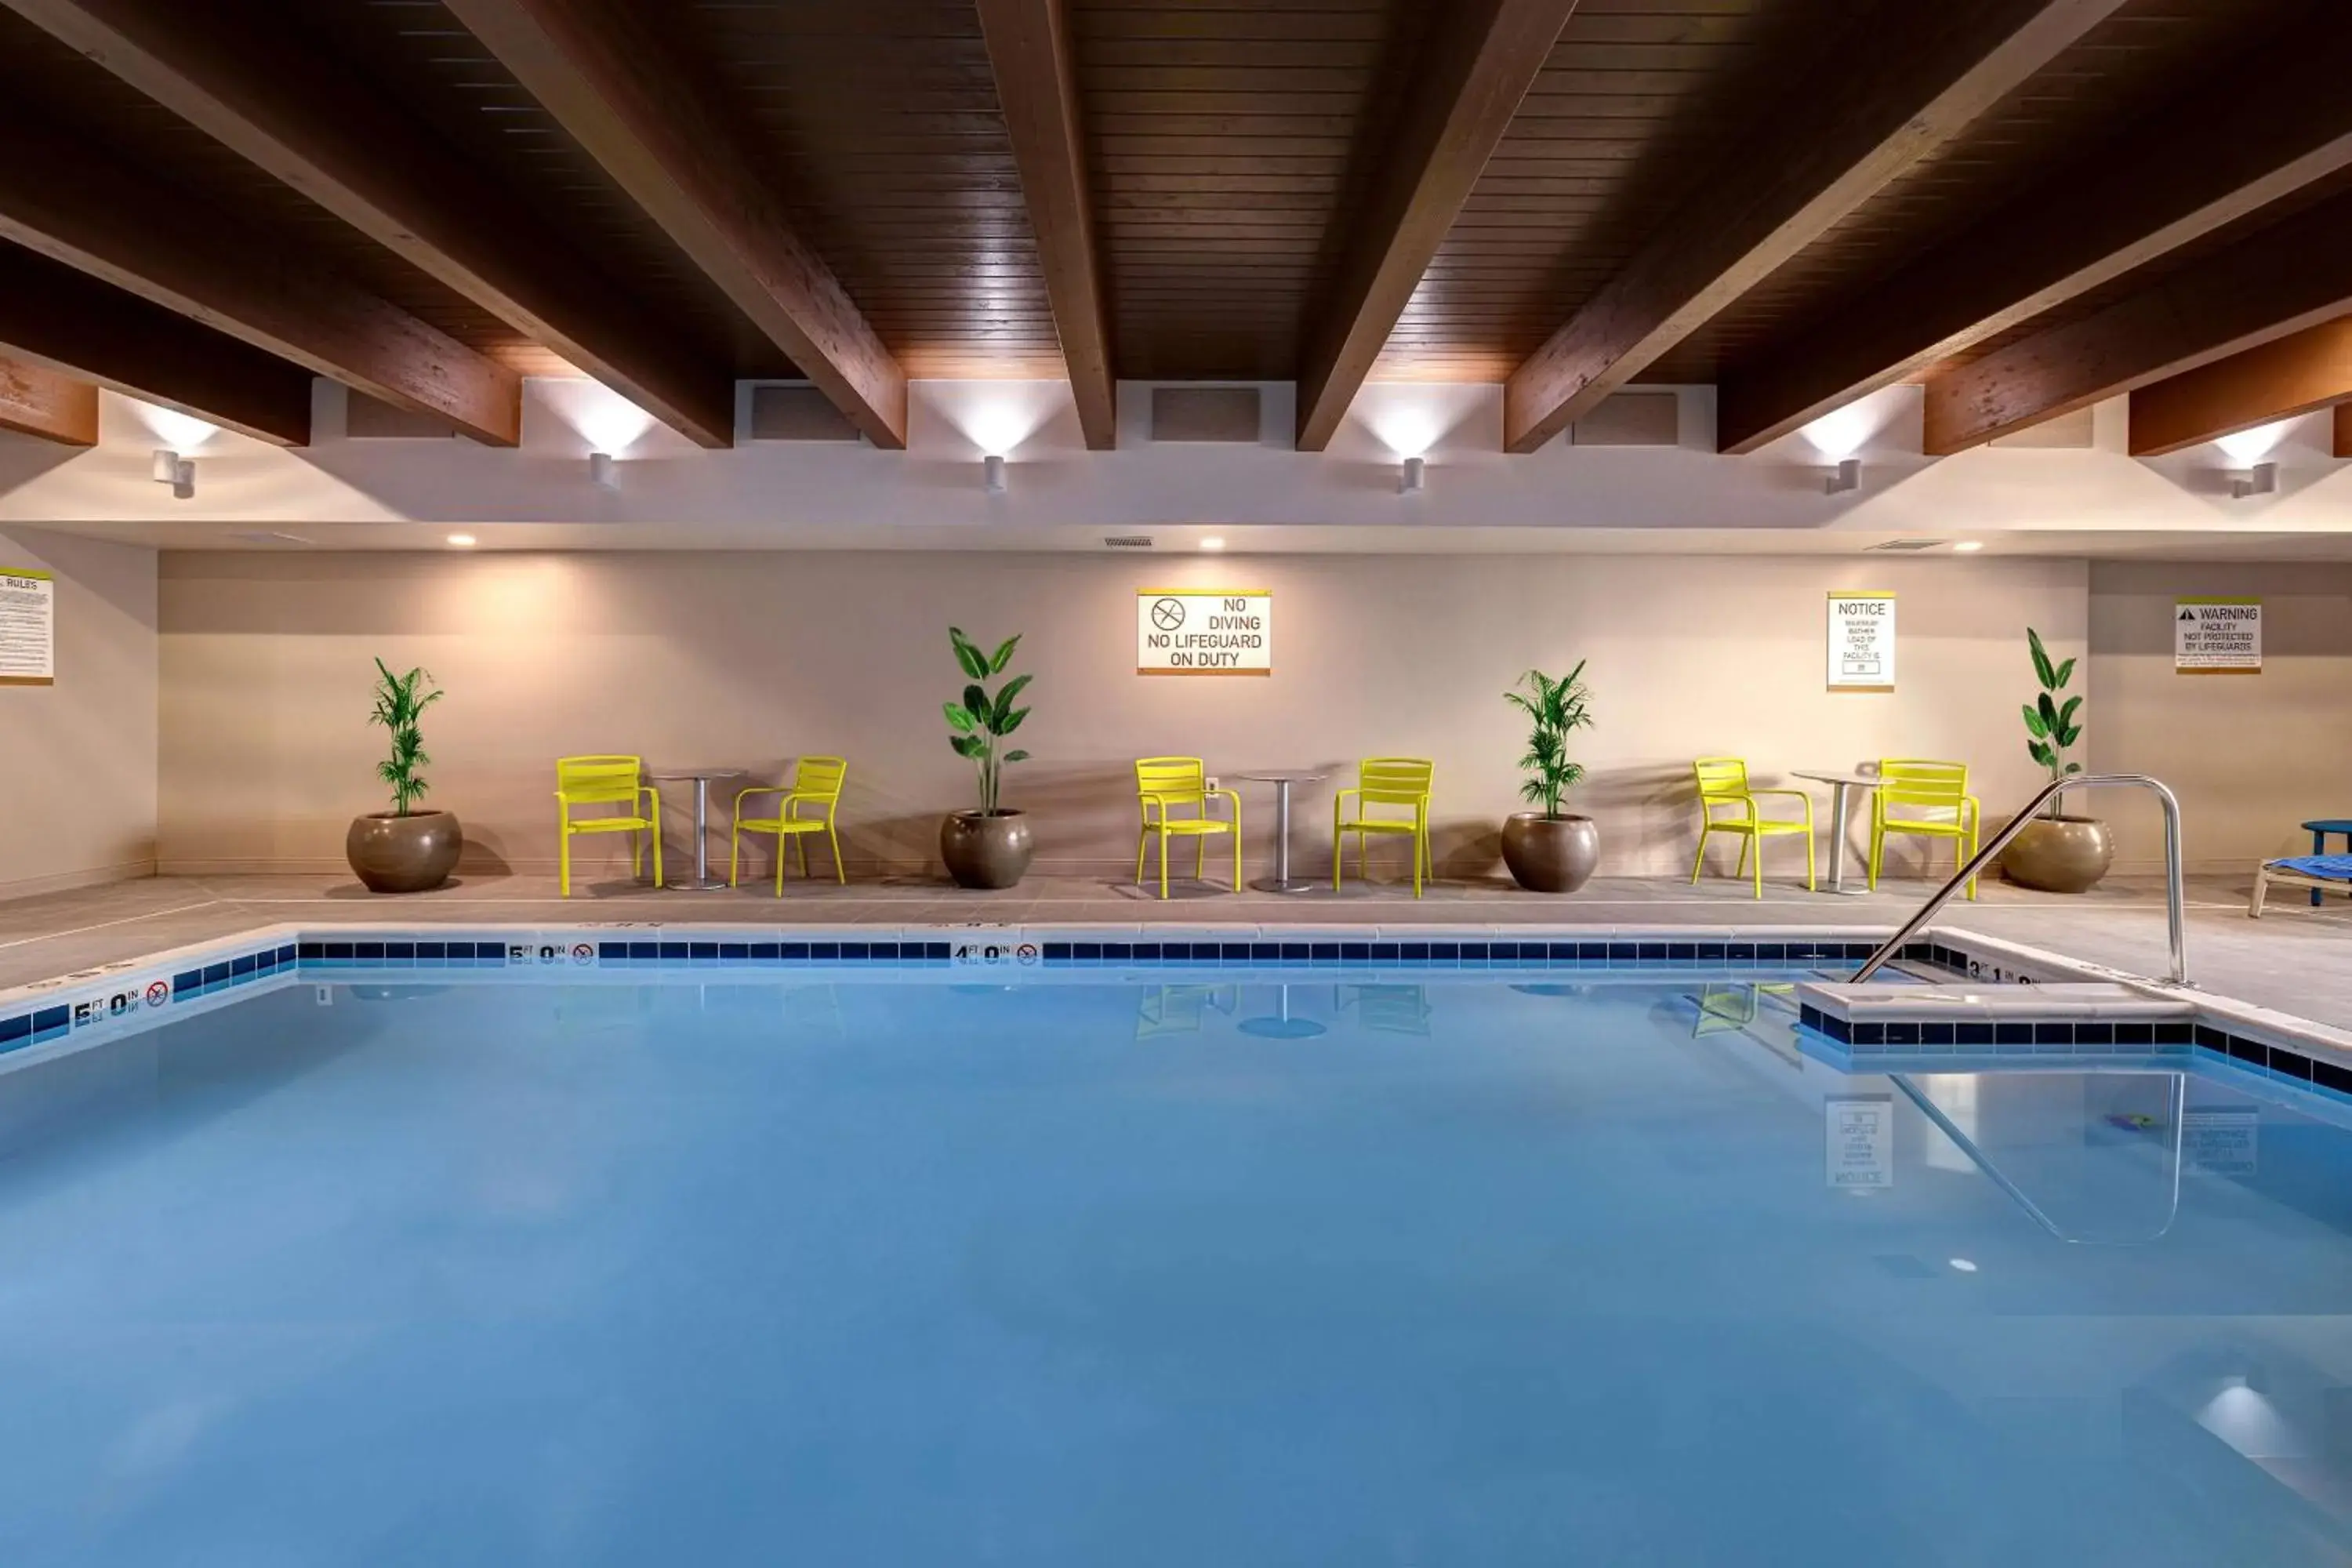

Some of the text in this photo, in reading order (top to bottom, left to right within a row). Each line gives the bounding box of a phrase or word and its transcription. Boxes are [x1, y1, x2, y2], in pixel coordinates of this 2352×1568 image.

[6, 578, 38, 590] RULES
[1224, 598, 1246, 612] NO
[1838, 603, 1886, 615] NOTICE
[2199, 608, 2258, 620] WARNING
[1209, 616, 1261, 630] DIVING
[1148, 634, 1261, 648] NO LIFEGUARD
[2185, 642, 2252, 651] BY LIFEGUARDS
[1171, 652, 1240, 666] ON DUTY
[523, 945, 533, 954] FT
[555, 946, 565, 954] IN
[969, 946, 978, 954] FT
[1000, 946, 1010, 954] IN
[93, 998, 103, 1011] FT
[128, 989, 139, 1001] IN
